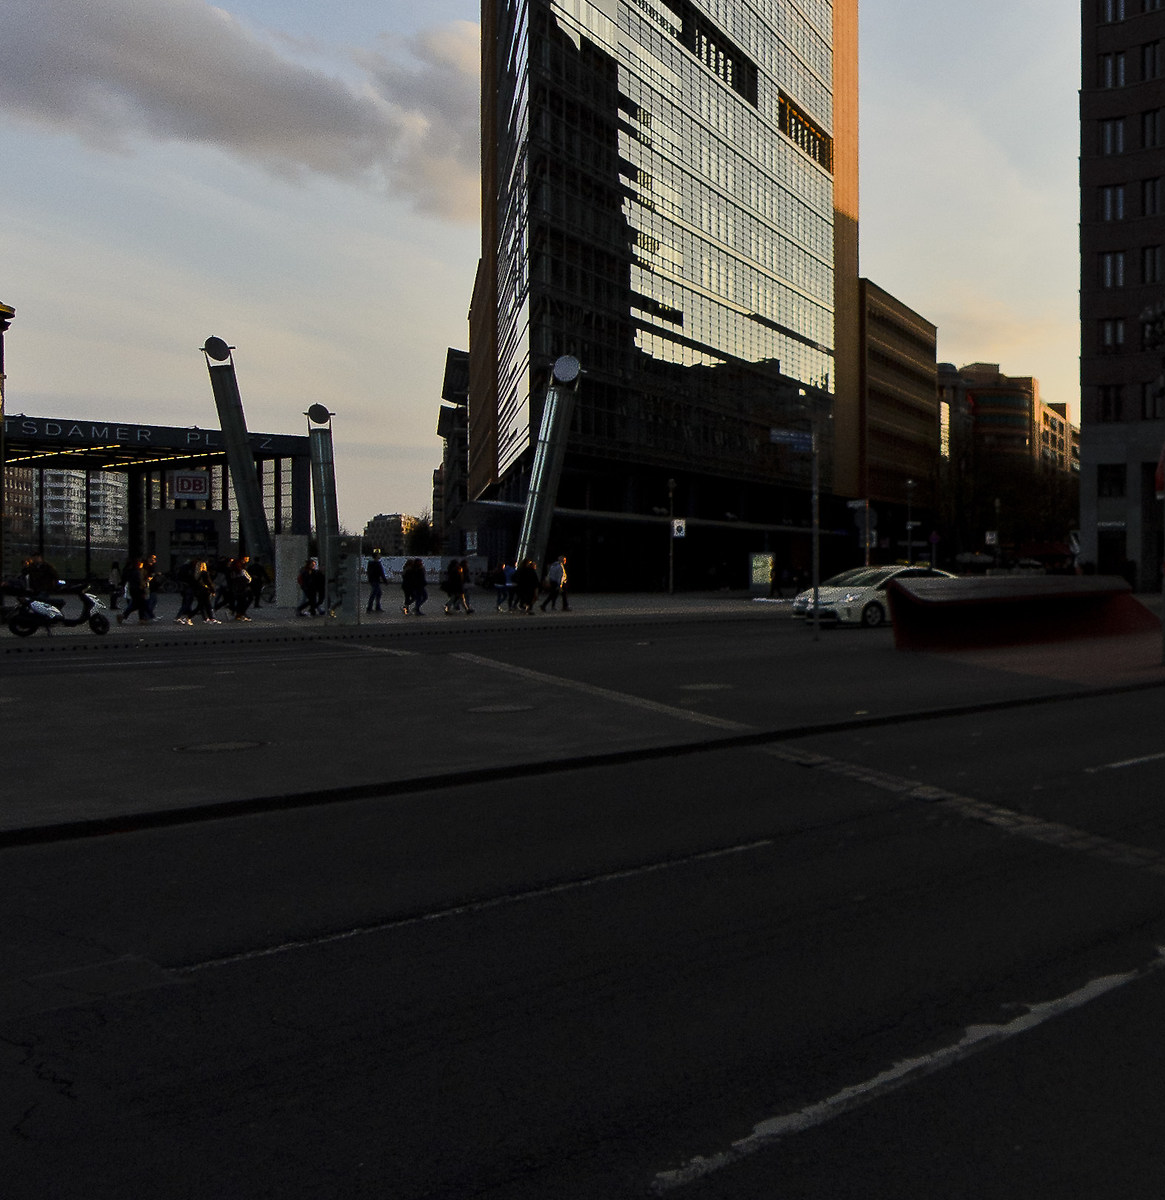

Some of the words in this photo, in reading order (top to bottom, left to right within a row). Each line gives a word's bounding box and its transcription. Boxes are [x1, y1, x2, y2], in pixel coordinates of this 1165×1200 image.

[5, 420, 151, 442] TSDAMER
[186, 432, 272, 449] PLZ
[180, 478, 203, 491] DB
